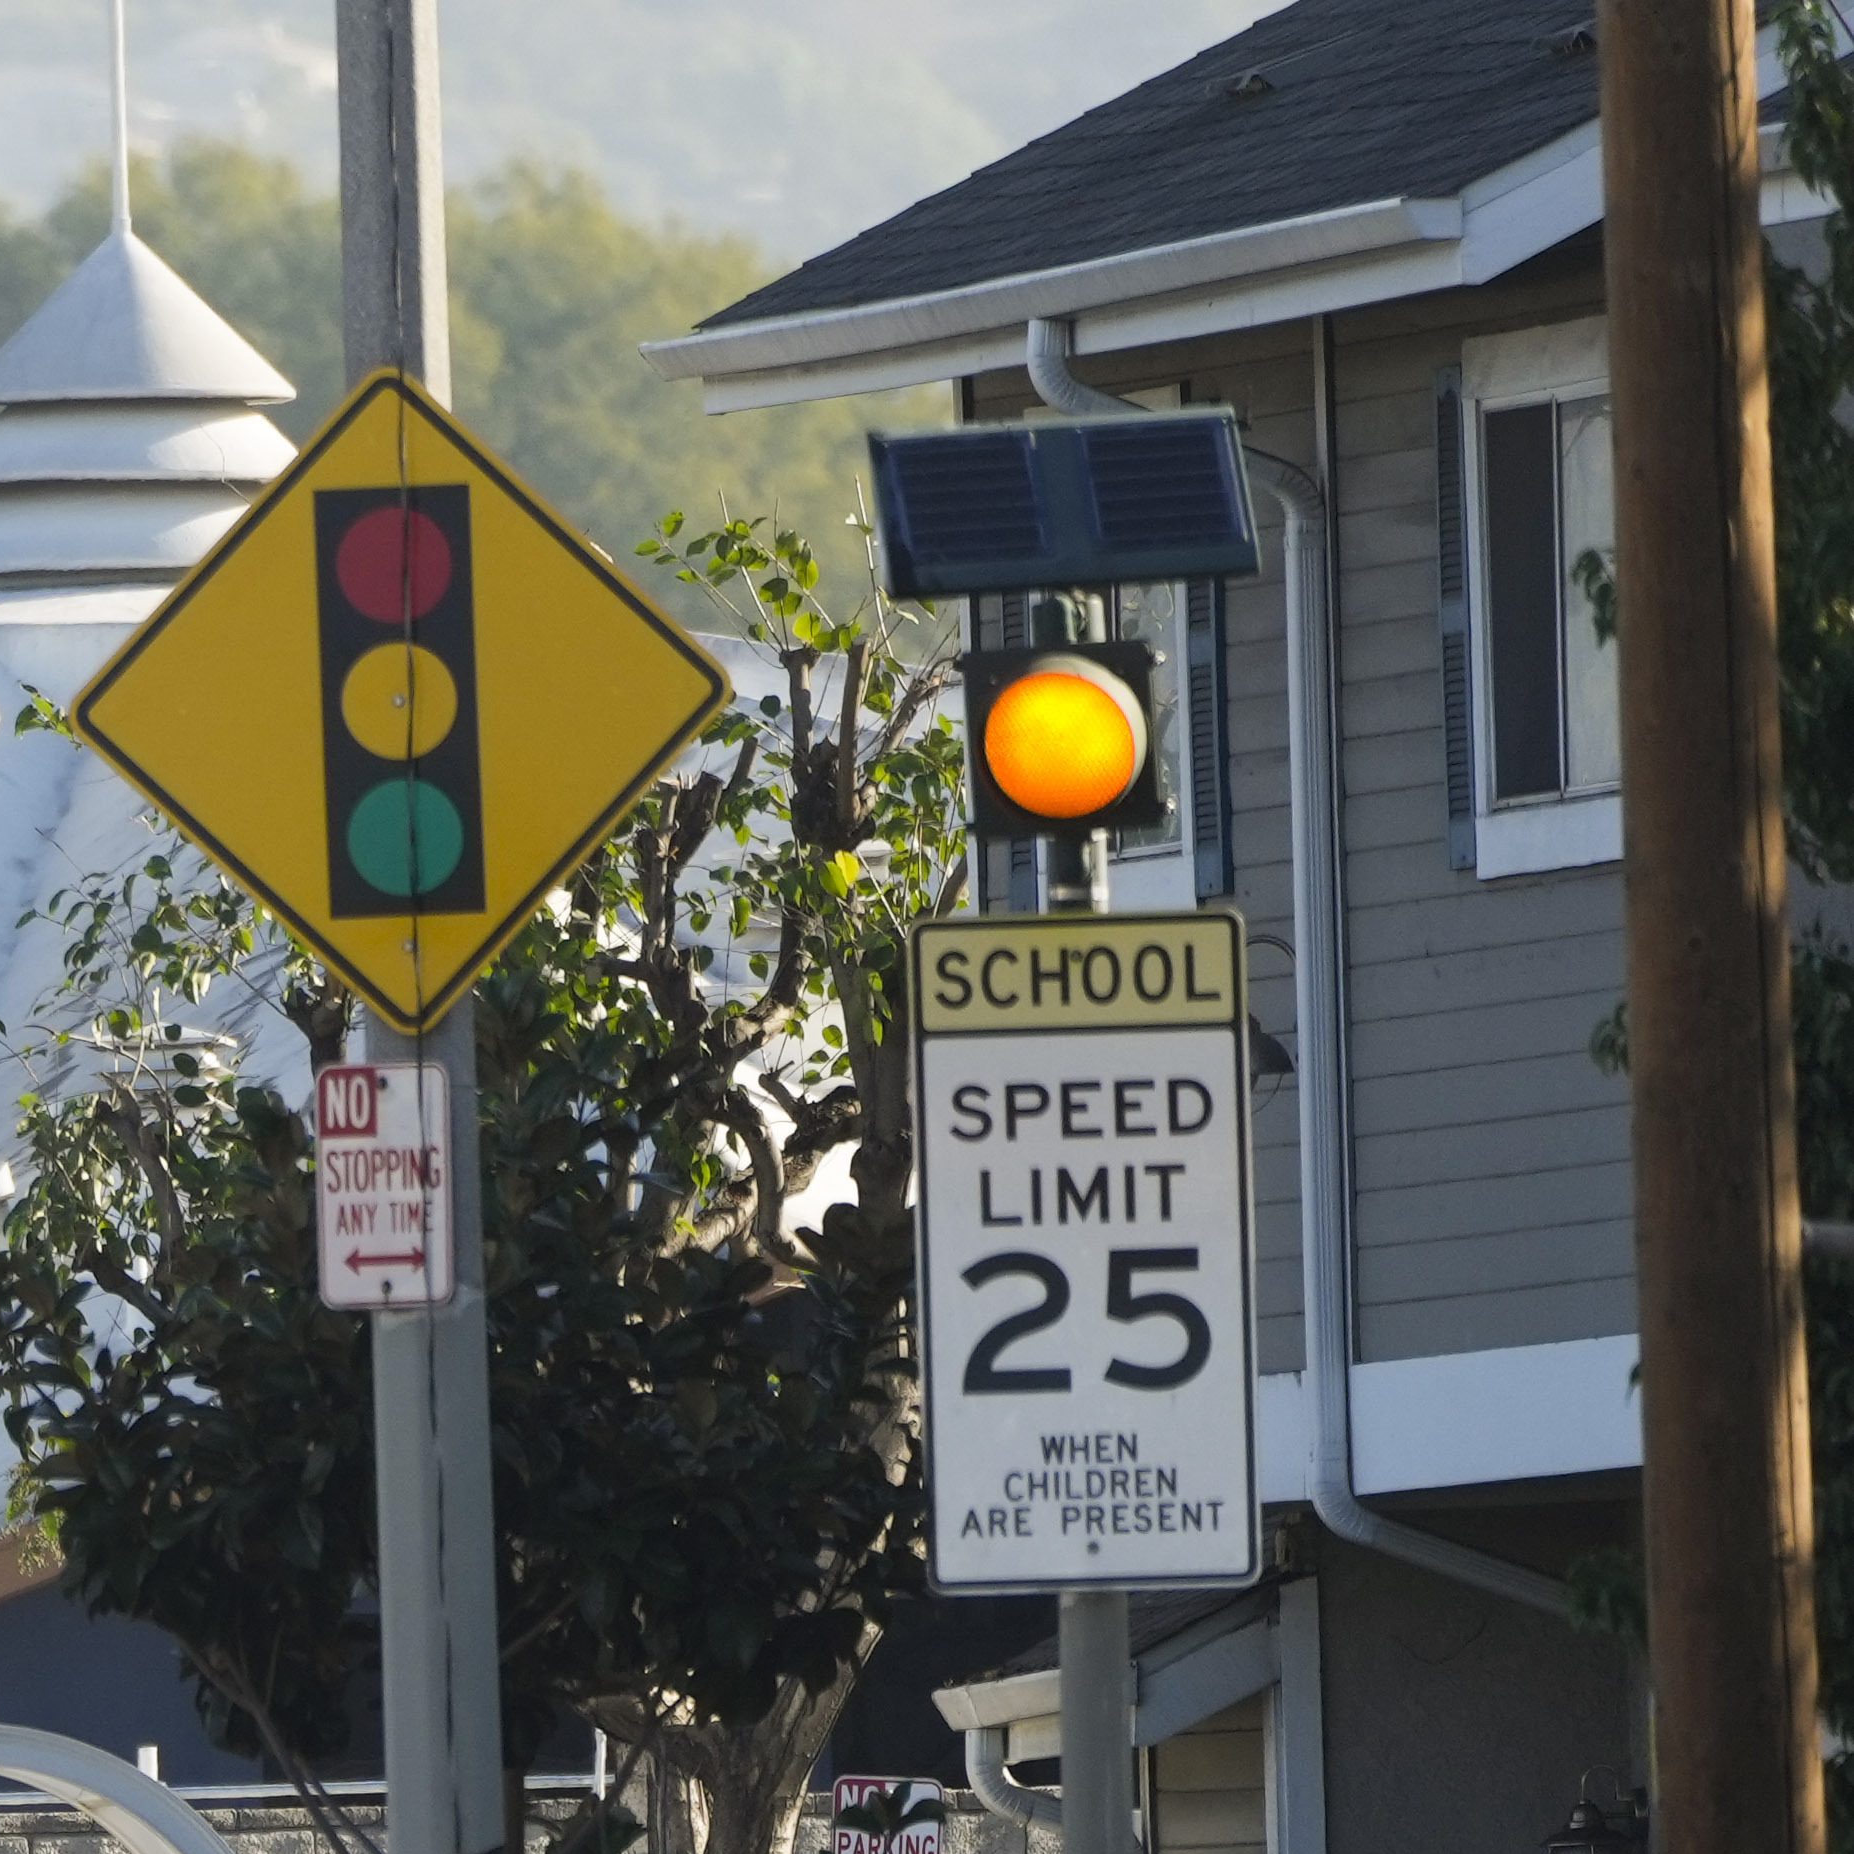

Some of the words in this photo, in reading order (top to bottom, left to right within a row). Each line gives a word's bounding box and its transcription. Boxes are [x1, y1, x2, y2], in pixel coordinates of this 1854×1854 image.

[934, 941, 1220, 1010] SCHOOL
[325, 1075, 371, 1130] NO
[950, 1078, 1214, 1141] SPEED
[326, 1146, 441, 1193] STOPPING
[336, 1203, 378, 1236] ANY
[389, 1200, 435, 1234] TIME
[979, 1163, 1186, 1228] LIMIT
[960, 1246, 1212, 1395] 25
[1040, 1432, 1138, 1464] WHEN
[1003, 1468, 1178, 1503] CHILDREN
[961, 1506, 1033, 1539] ARE
[1060, 1500, 1224, 1537] PRESENT
